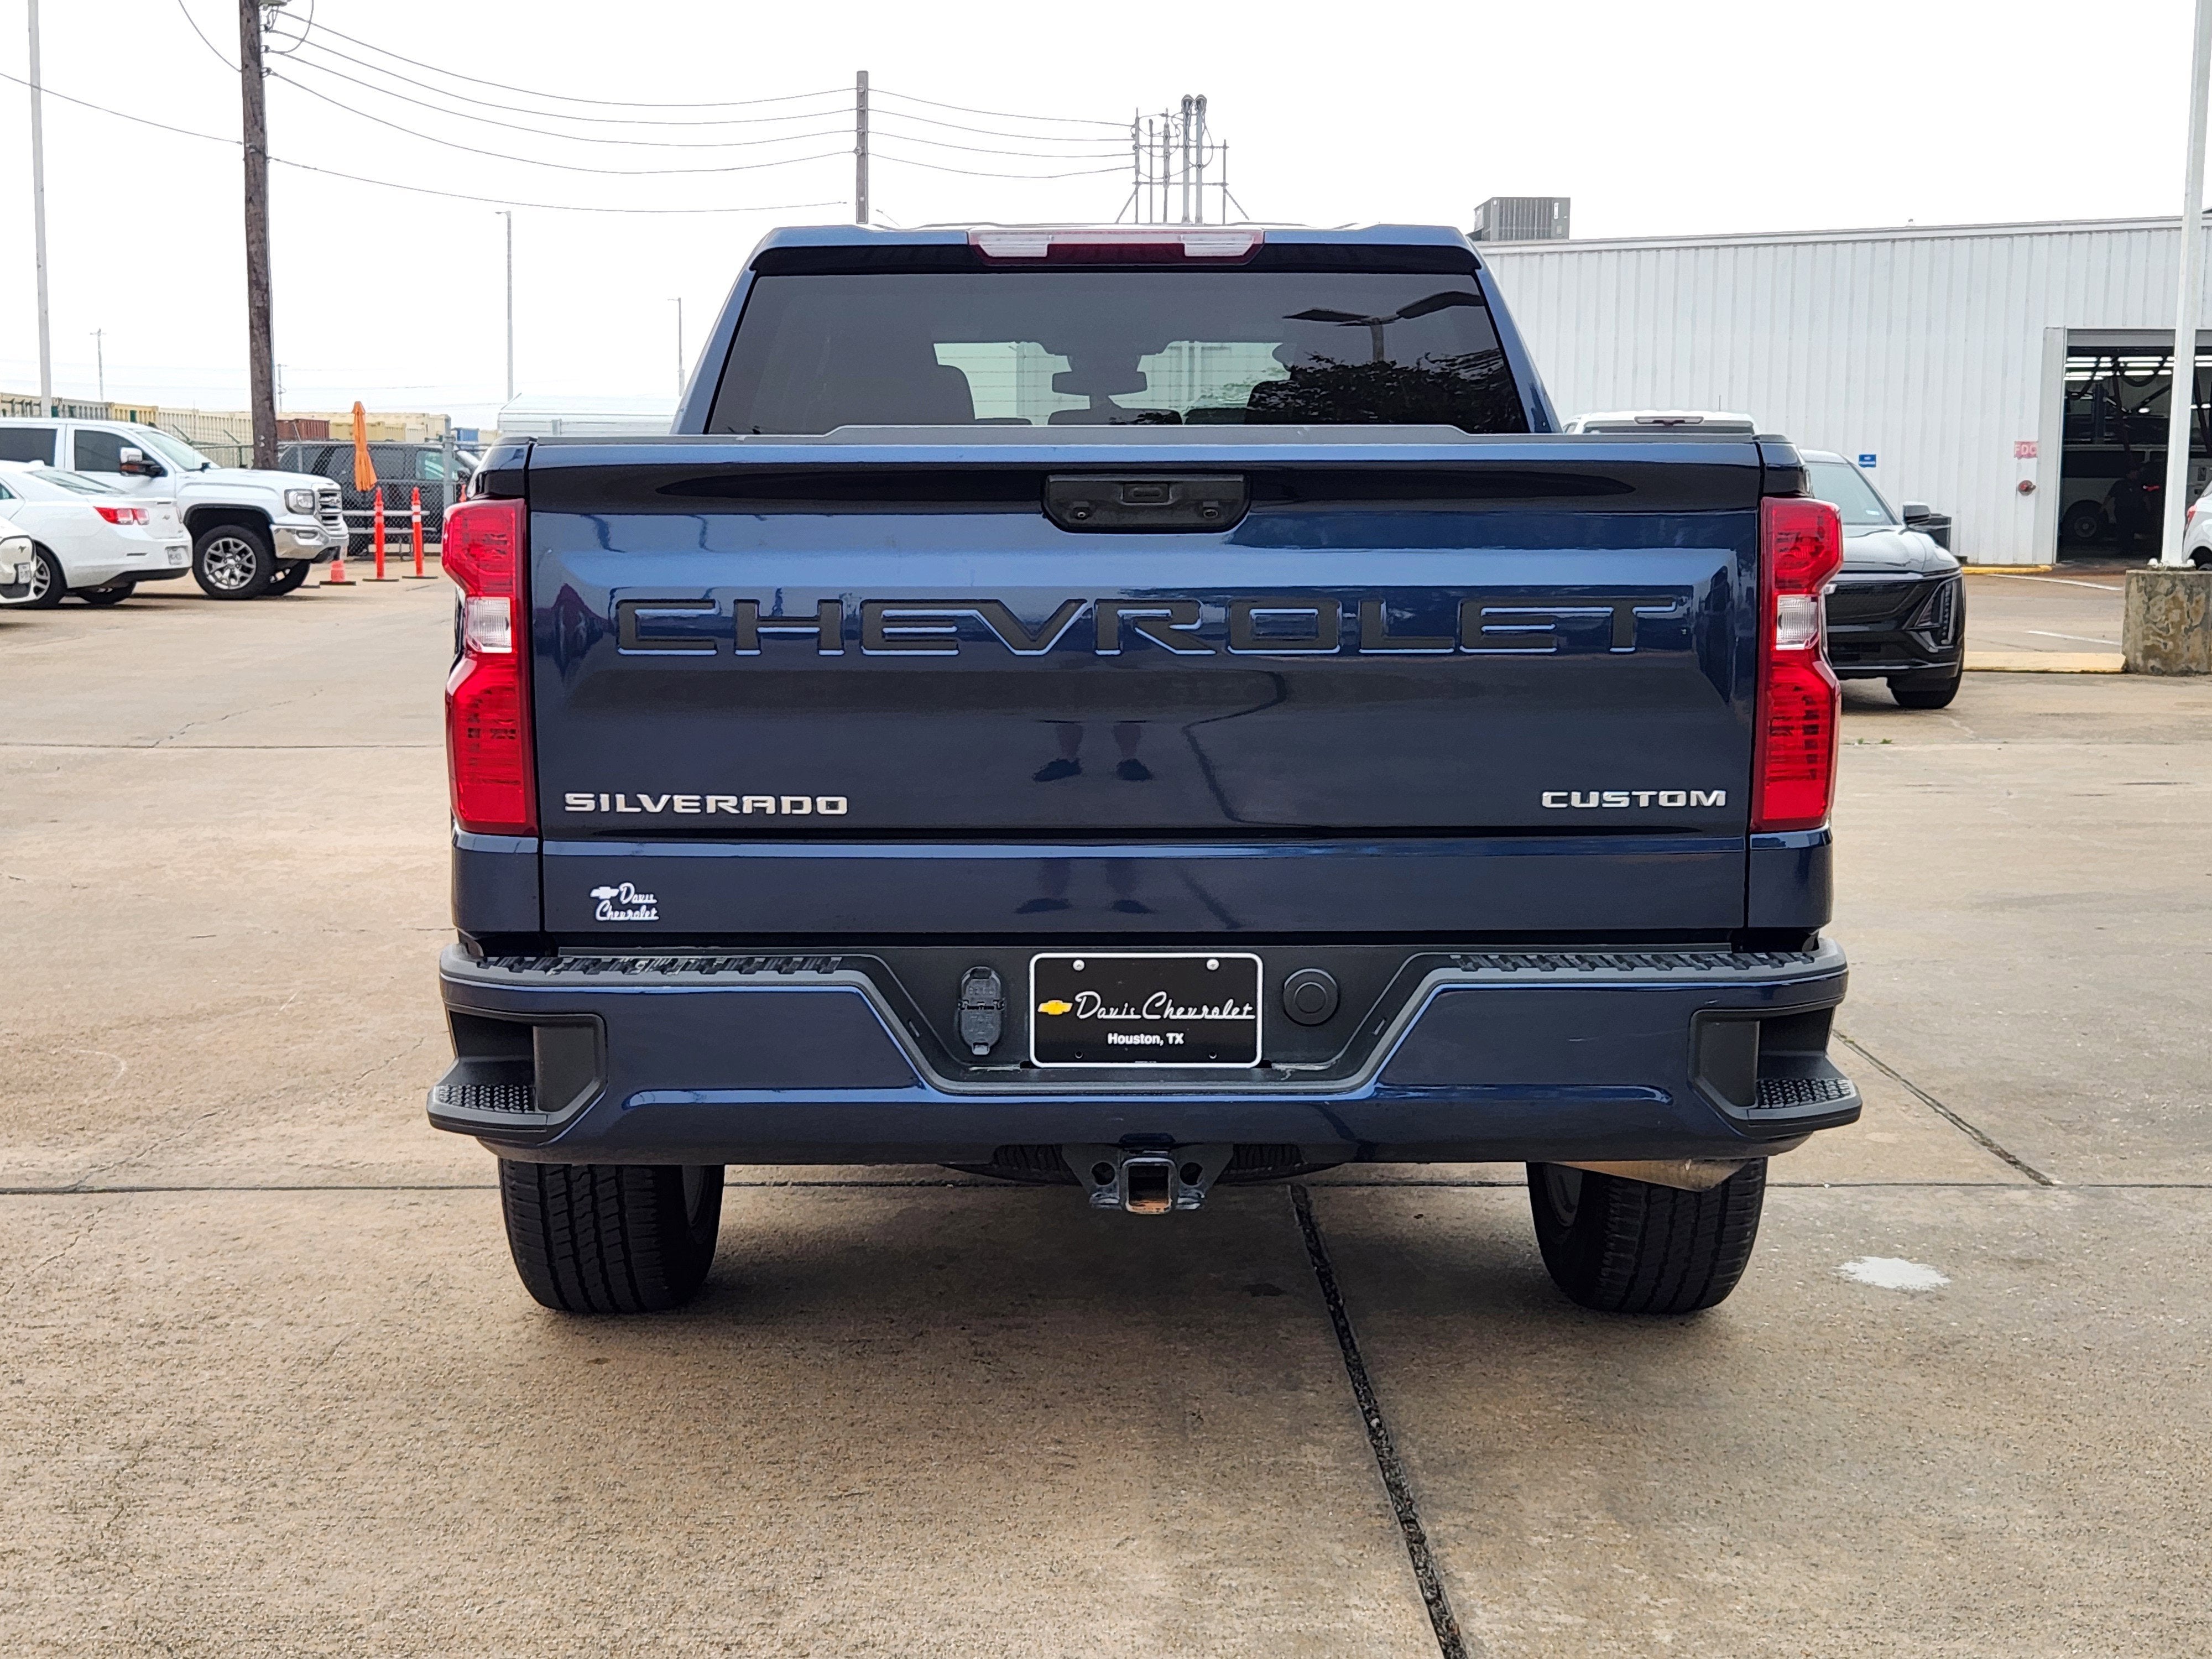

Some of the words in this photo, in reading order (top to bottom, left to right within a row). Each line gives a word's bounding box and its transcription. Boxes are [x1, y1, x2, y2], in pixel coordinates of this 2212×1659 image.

[615, 596, 1677, 656] CHEVROLET
[564, 792, 848, 815] SILVERADO
[1541, 790, 1727, 808] CUSTOM
[595, 899, 660, 921] Chevrolet
[1074, 990, 1142, 1019] Davis
[1142, 990, 1256, 1020] Chevrolet
[1107, 1032, 1164, 1046] Houston,
[1166, 1032, 1185, 1045] TX
